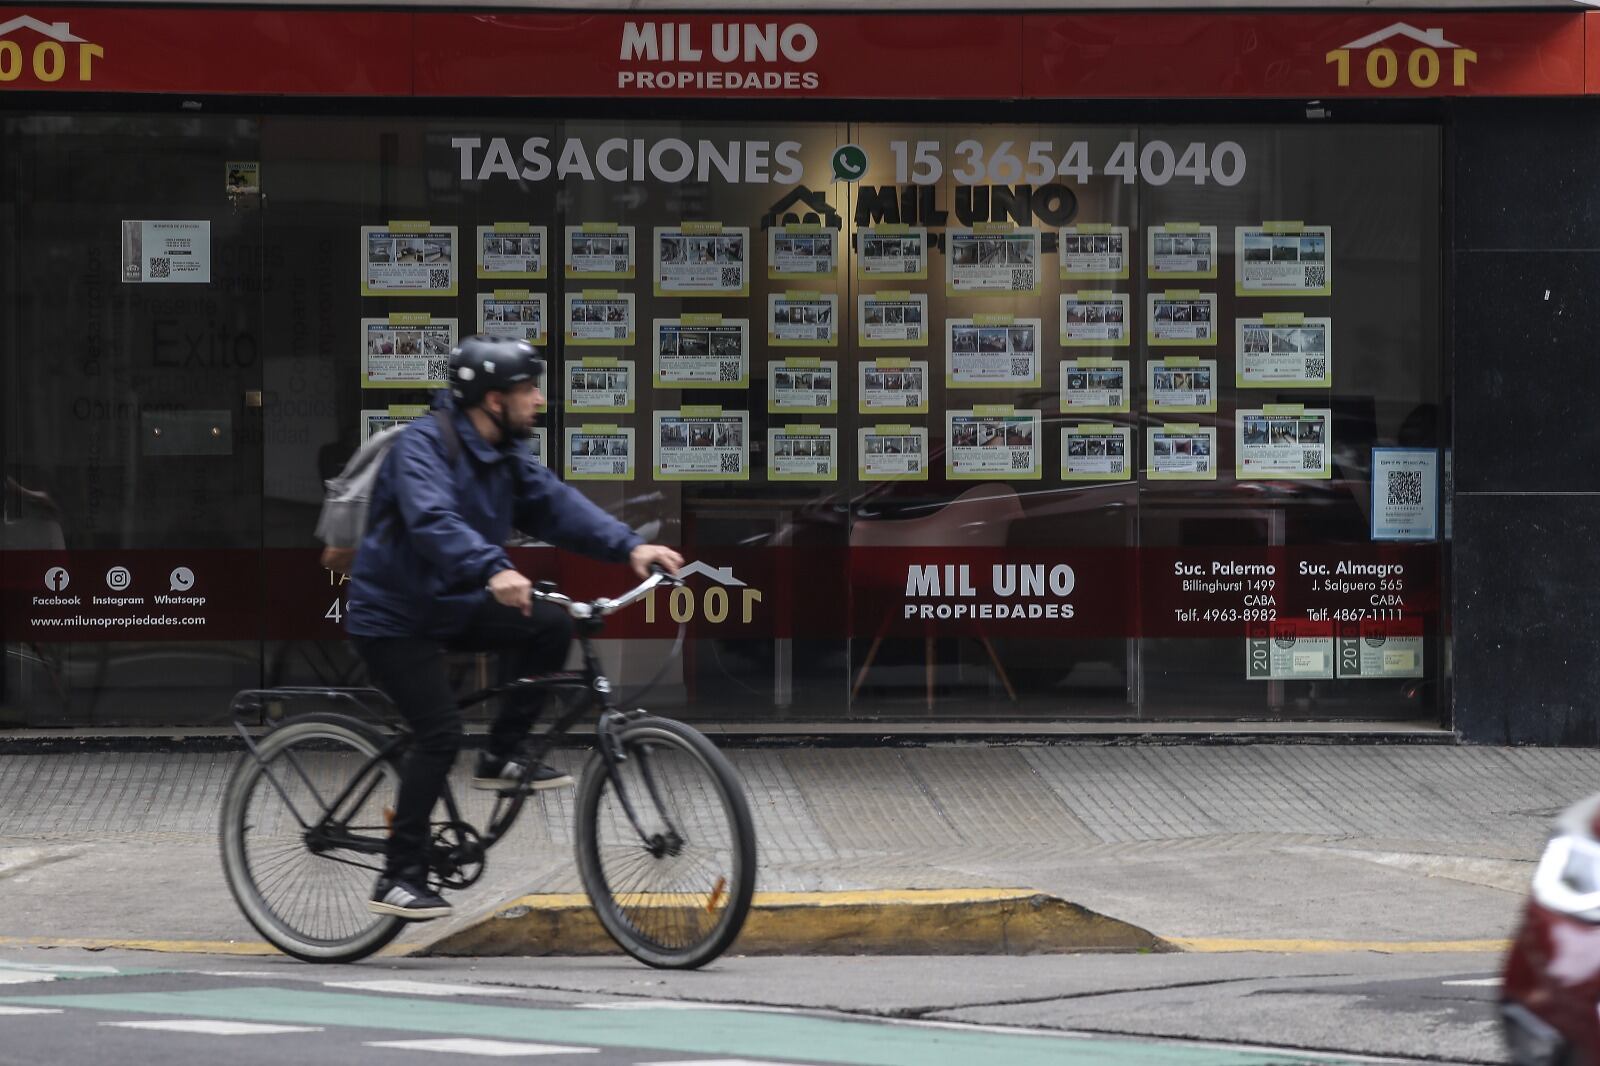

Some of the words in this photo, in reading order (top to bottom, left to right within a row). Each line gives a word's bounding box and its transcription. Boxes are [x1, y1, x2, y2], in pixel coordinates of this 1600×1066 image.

[619, 22, 703, 62] MIL
[711, 23, 818, 63] UNO
[1325, 48, 1478, 88] 1001
[618, 71, 819, 89] PROPIEDADES
[451, 137, 804, 184] TASACIONES
[889, 140, 943, 185] 15
[952, 139, 1093, 186] 3654
[1103, 140, 1247, 187] 4040
[854, 185, 948, 227] MIL
[955, 184, 1079, 228] UNO
[1174, 561, 1206, 576] Suc.
[1212, 560, 1276, 576] Palermo
[1299, 560, 1330, 576] Suc.
[1335, 560, 1404, 579] Almagro
[905, 564, 976, 597] MIL
[992, 563, 1075, 597] UNO
[1182, 579, 1242, 593] Billinghurst
[1247, 579, 1276, 592] 1499
[1312, 579, 1320, 592] J.
[1324, 578, 1376, 593] Salguero
[1380, 579, 1403, 592] 565
[32, 595, 81, 606] Facebook
[92, 595, 144, 607] Instagram
[154, 595, 206, 606] Whatsapp
[636, 586, 762, 624] 1001
[1243, 594, 1276, 607] CABA
[1370, 594, 1404, 607] CABA
[904, 603, 1075, 619] PROPIEDADES
[1174, 608, 1200, 622] Telf.
[1203, 608, 1277, 622] 4963-8982
[1306, 607, 1330, 622] Telf.
[1333, 608, 1402, 622] 4867-1111
[30, 614, 206, 628] www.milunopropiedades.com
